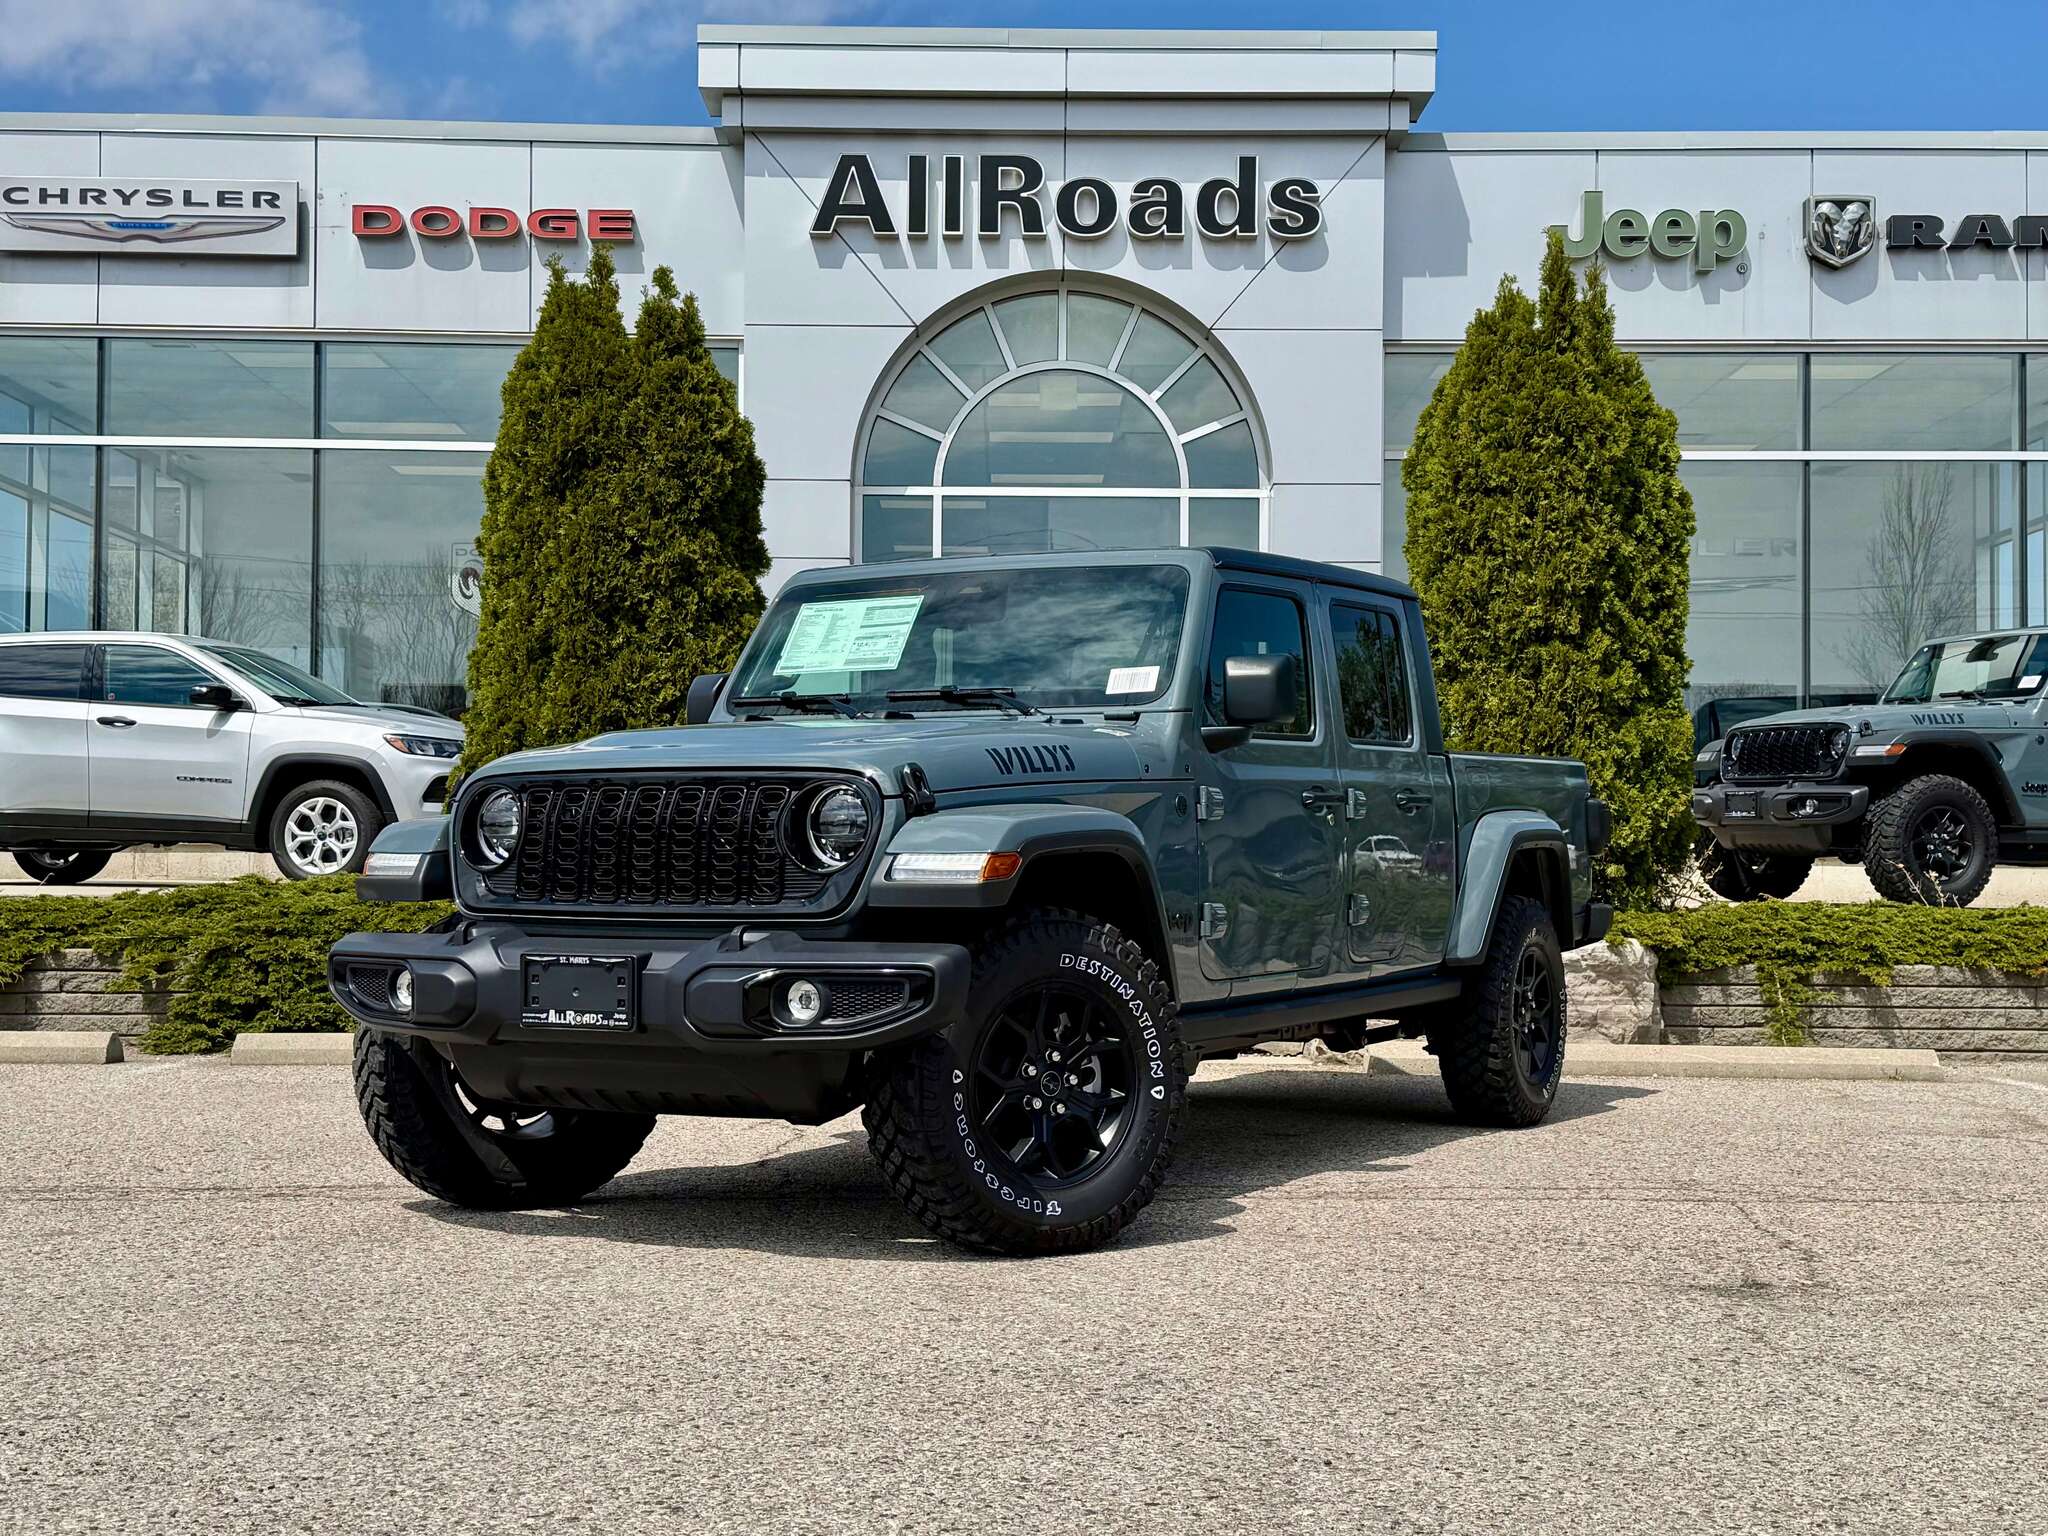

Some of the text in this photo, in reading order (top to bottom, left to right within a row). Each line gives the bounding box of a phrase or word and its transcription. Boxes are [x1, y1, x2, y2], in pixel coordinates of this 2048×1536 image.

[2, 186, 281, 209] CHRYSLER
[351, 204, 635, 240] DODGE
[809, 152, 1322, 241] AllRoads
[1549, 189, 1748, 273] Jeep
[1910, 713, 1965, 725] WILLYS
[985, 744, 1076, 775] WILLYS
[1059, 953, 1164, 1078] DESTINATION
[953, 1092, 1062, 1216] Firestone
